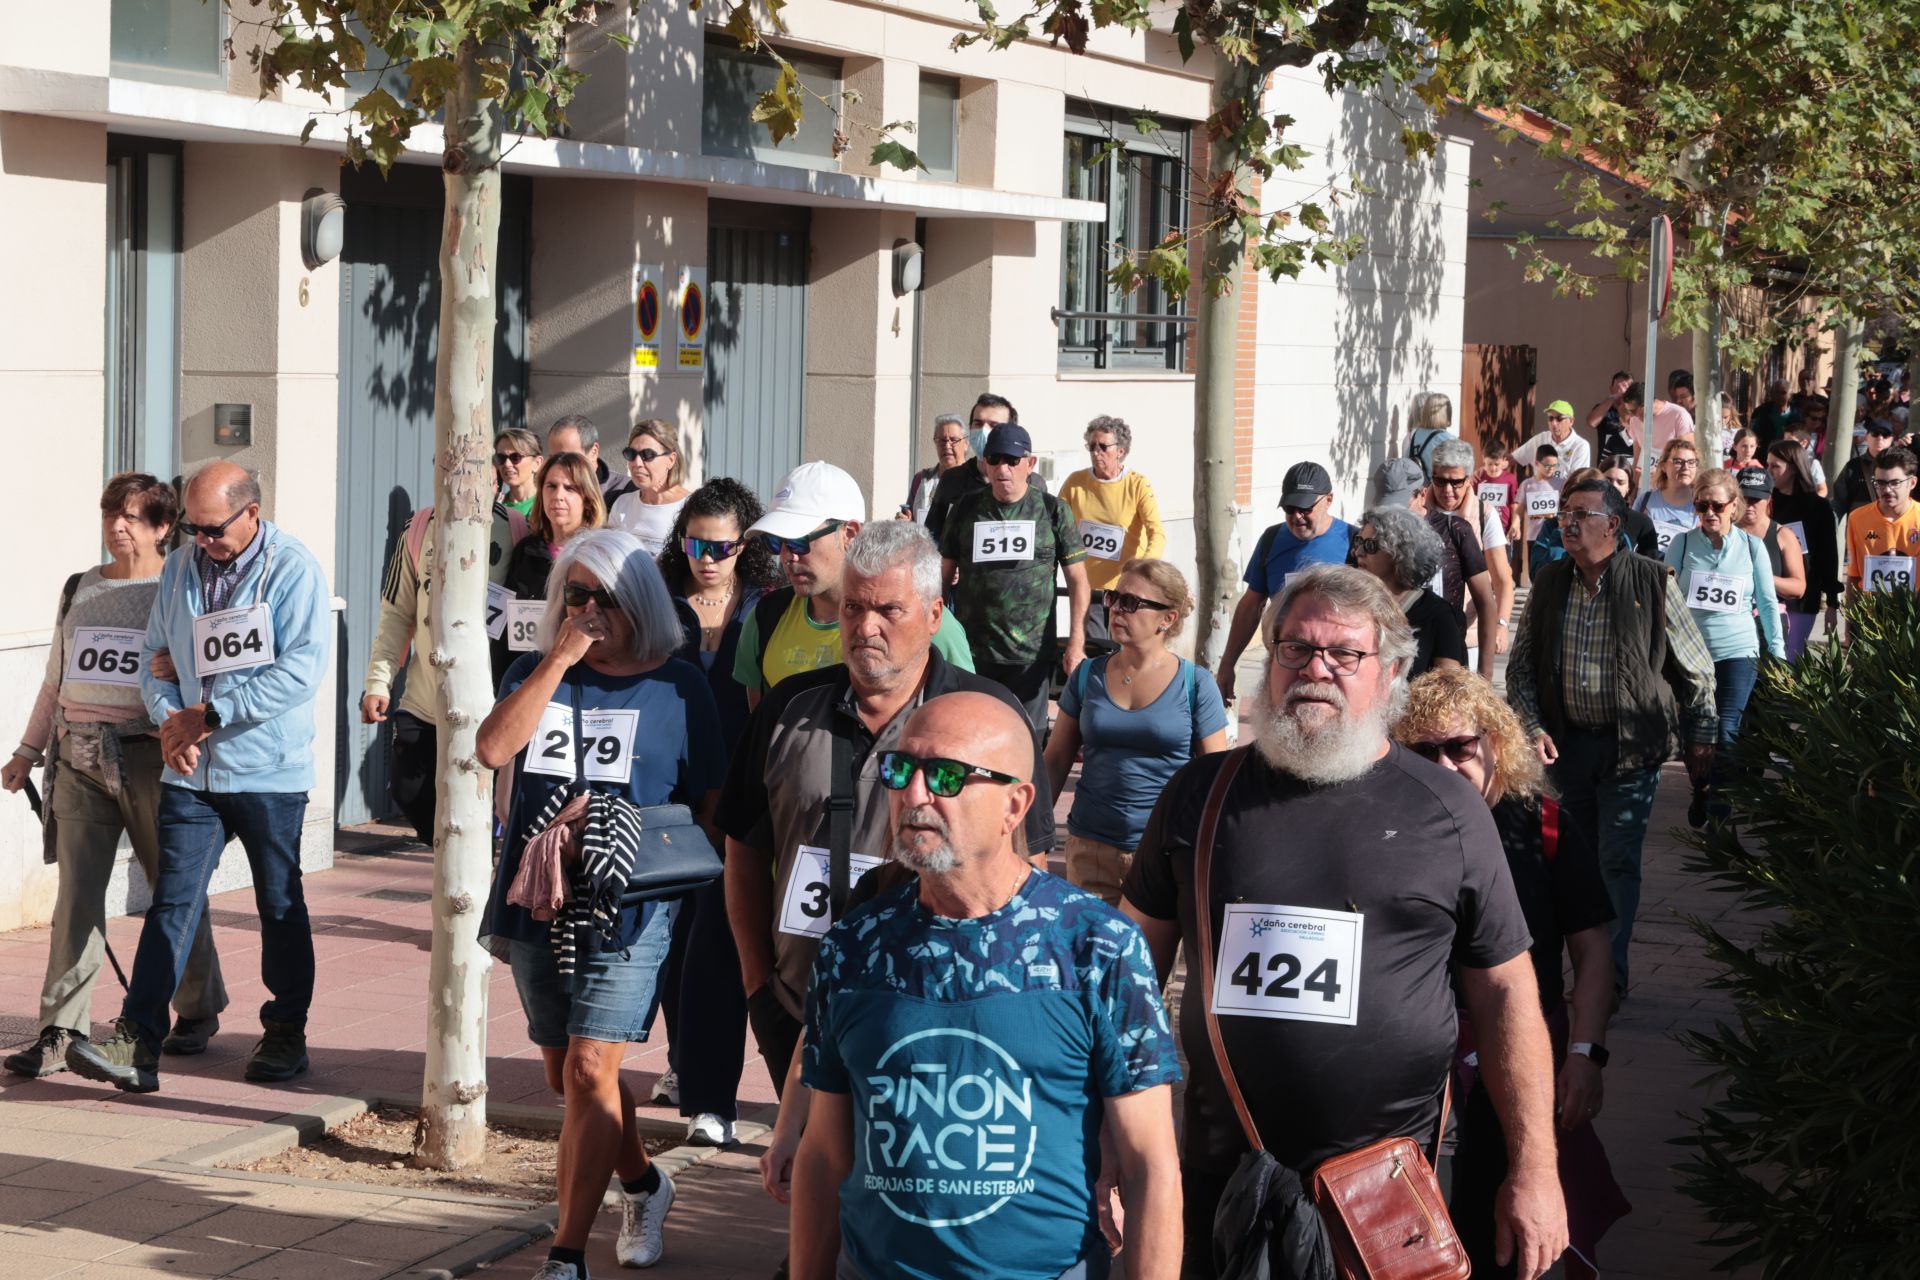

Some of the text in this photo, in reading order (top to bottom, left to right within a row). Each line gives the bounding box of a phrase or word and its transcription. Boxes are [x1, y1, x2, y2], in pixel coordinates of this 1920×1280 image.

[298, 276, 310, 308] 6
[891, 306, 901, 338] 4
[1480, 492, 1503, 501] 097
[1531, 499, 1556, 510] 099
[981, 536, 1027, 555] 519
[1082, 533, 1117, 552] 029
[1871, 569, 1910, 586] 049
[1695, 586, 1737, 606] 536
[204, 623, 263, 662] 064
[78, 647, 140, 675] 065
[541, 729, 621, 765] 279
[1263, 919, 1326, 932] daño cerebral
[1230, 951, 1342, 1003] 424
[866, 1063, 1033, 1123] PIÑÓN
[873, 1122, 1016, 1172] RACE
[864, 1174, 1036, 1196] PEDRAJAS DE SAN ESTEBAN
